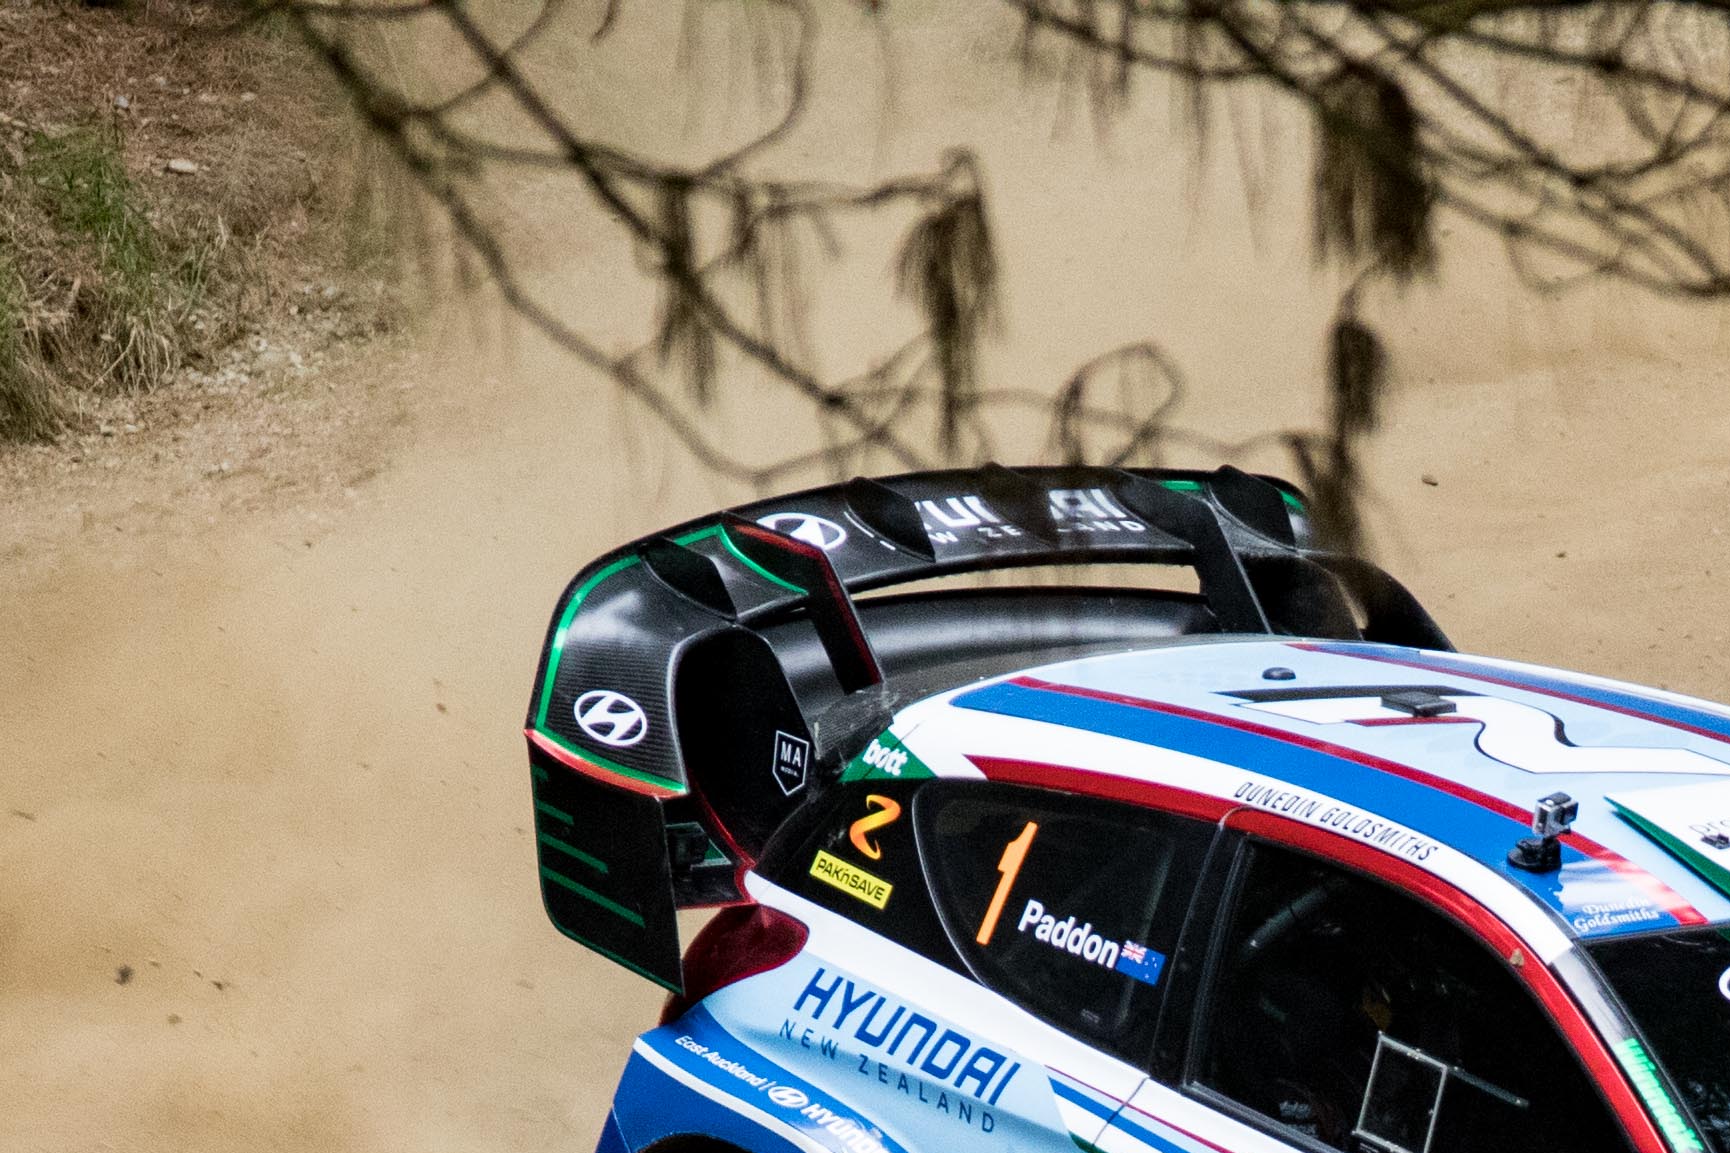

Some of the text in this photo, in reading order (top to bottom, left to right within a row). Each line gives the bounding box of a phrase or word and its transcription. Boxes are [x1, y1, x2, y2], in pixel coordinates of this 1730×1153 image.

[780, 741, 802, 767] MA
[863, 738, 908, 777] bott
[1234, 782, 1439, 861] DUNEDIN GOLDSMITHS
[976, 821, 1039, 946] 1
[1018, 899, 1121, 970] Paddon
[1574, 907, 1660, 933] Goldsmiths
[675, 1035, 768, 1090] East Auckland
[793, 967, 1021, 1106] HYUNDAI
[779, 1018, 995, 1133] NEW ZEALAND
